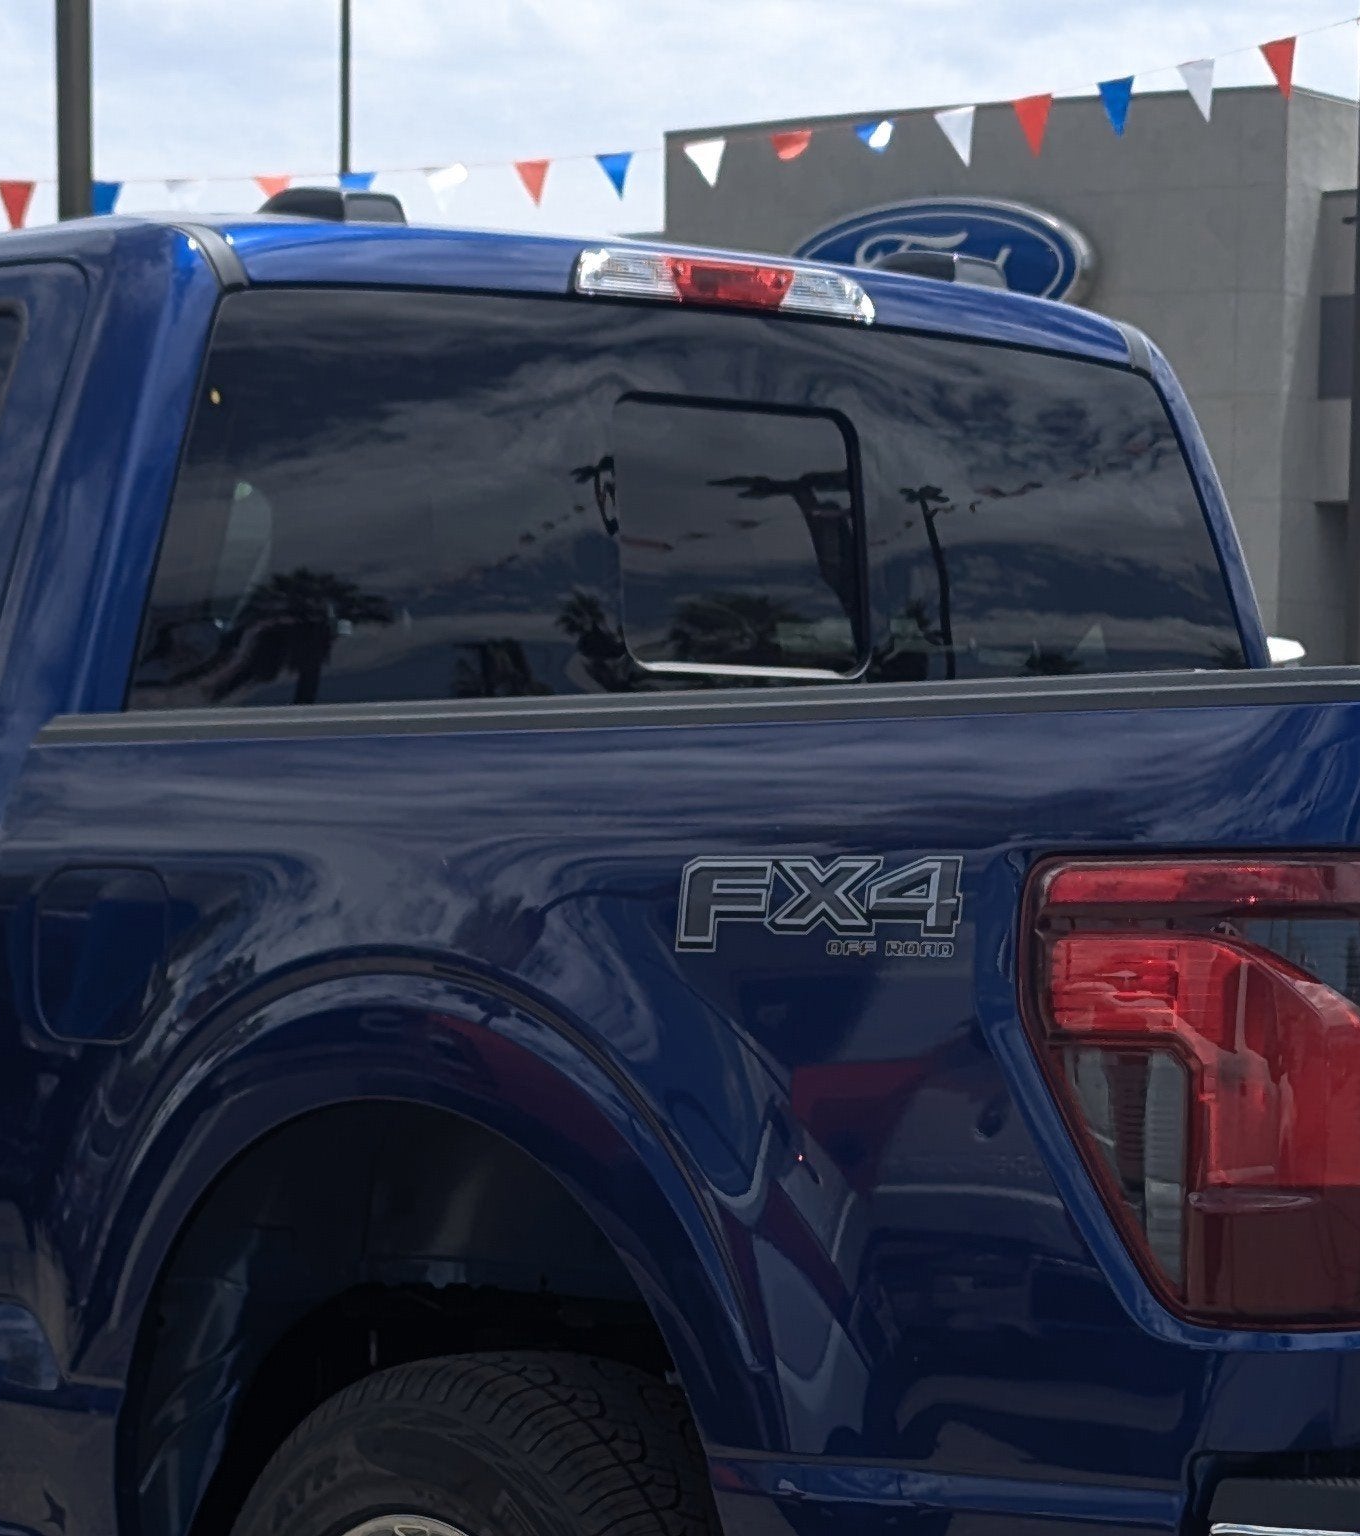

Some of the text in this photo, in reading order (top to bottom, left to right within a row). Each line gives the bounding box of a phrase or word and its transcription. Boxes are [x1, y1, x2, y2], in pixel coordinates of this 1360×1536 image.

[675, 855, 963, 952] FX4
[826, 939, 954, 957] OFF ROAD
